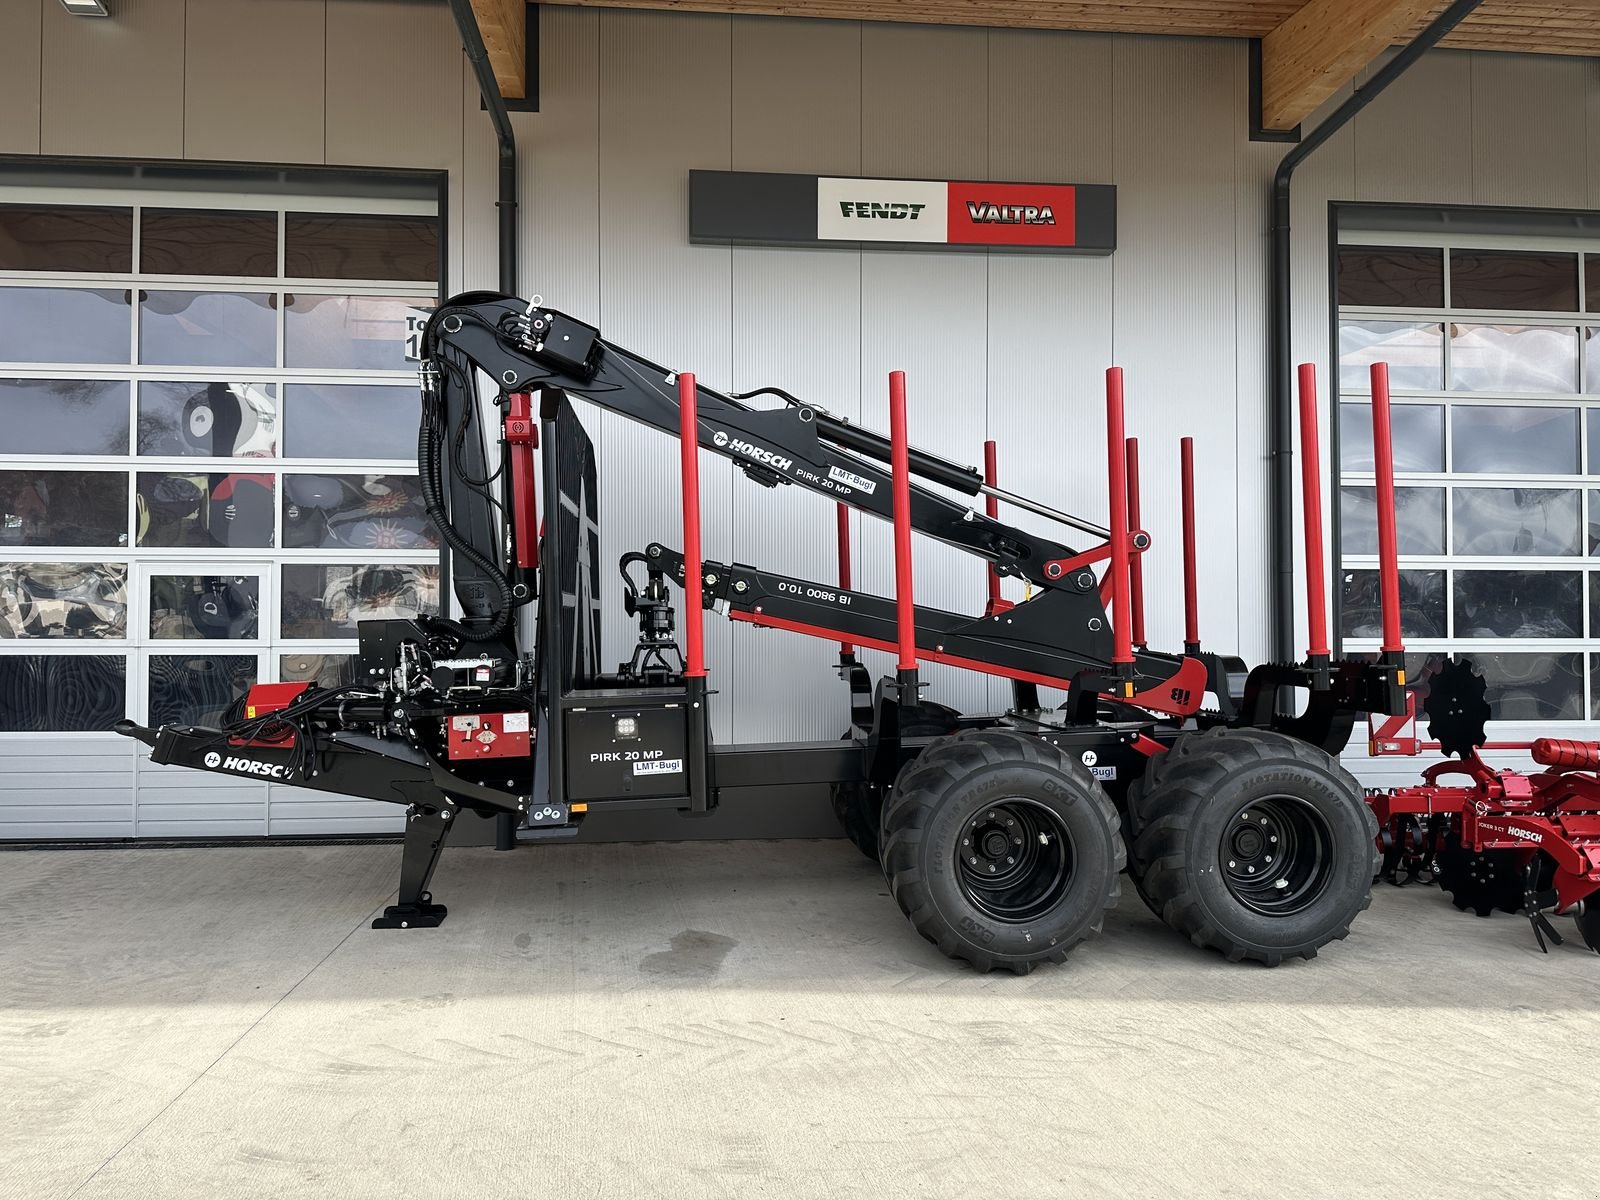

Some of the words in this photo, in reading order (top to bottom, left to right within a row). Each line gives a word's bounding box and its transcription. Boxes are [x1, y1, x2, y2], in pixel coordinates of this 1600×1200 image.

[840, 201, 926, 220] FENDT
[966, 201, 1056, 225] VALTRA
[406, 316, 427, 331] To
[406, 334, 418, 357] 1
[729, 438, 793, 471] HORSCH
[795, 468, 820, 484] PIRK
[821, 478, 834, 489] 20
[835, 484, 852, 495] MP
[832, 466, 873, 490] LMT-Bugl
[778, 582, 803, 595] 10.0
[807, 588, 836, 602] 9800
[839, 595, 852, 605] IB
[590, 752, 621, 762] PIRK
[624, 751, 640, 760] 20
[643, 750, 663, 760] MP
[636, 761, 680, 771] LMT-Bugl
[1092, 767, 1114, 777] Bugl
[1042, 780, 1078, 805] BKT
[1507, 826, 1543, 843] HORSCH
